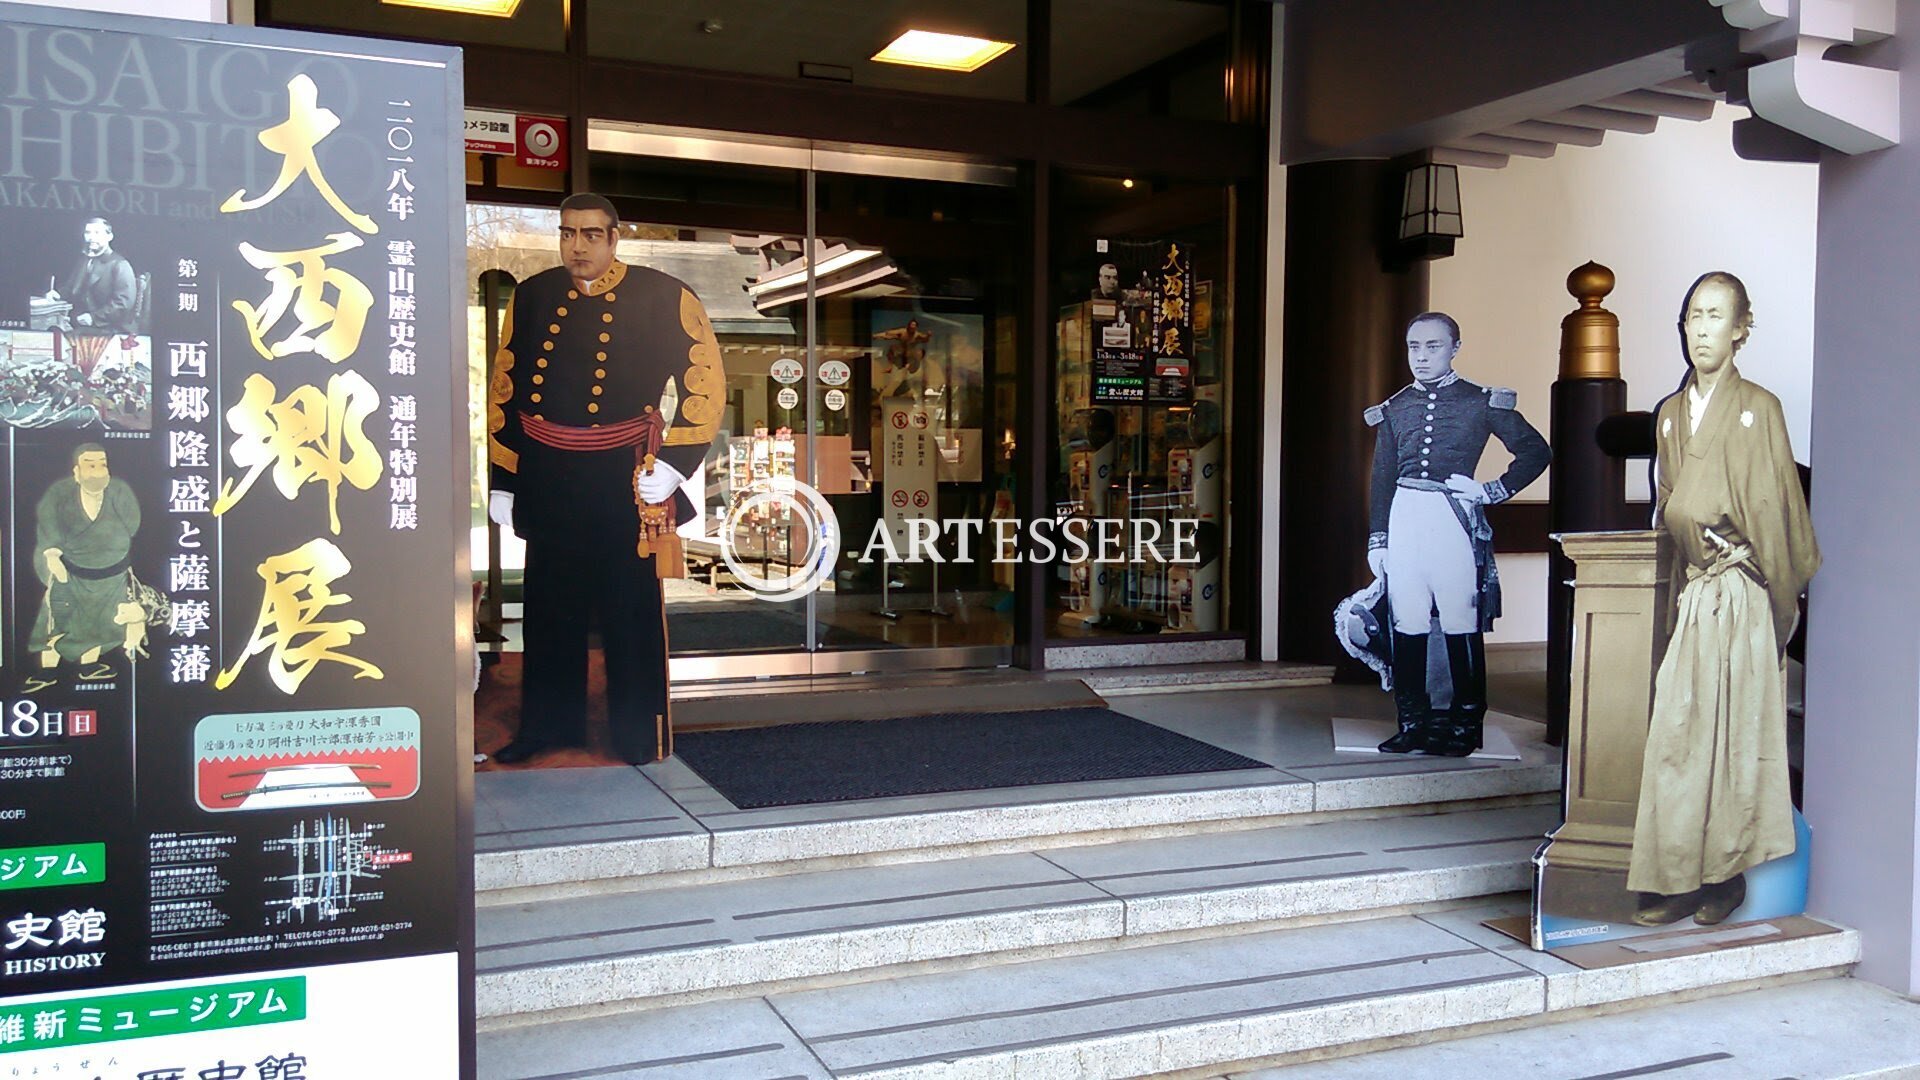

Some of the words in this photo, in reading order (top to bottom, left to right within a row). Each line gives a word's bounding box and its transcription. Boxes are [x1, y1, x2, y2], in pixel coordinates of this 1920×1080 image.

[386, 99, 415, 221] 二〇一八年
[178, 258, 198, 313] 第一期
[213, 73, 384, 695] 大西郷展
[389, 394, 418, 530] 通年特別展
[167, 340, 211, 683] 西郷隆盛と薩摩藩
[0, 809, 26, 820] 00円
[1, 852, 88, 881] ジアム
[5, 907, 107, 950] 史館
[5, 952, 106, 976] HISTORY
[0, 987, 288, 1045] 維新ミュージアム
